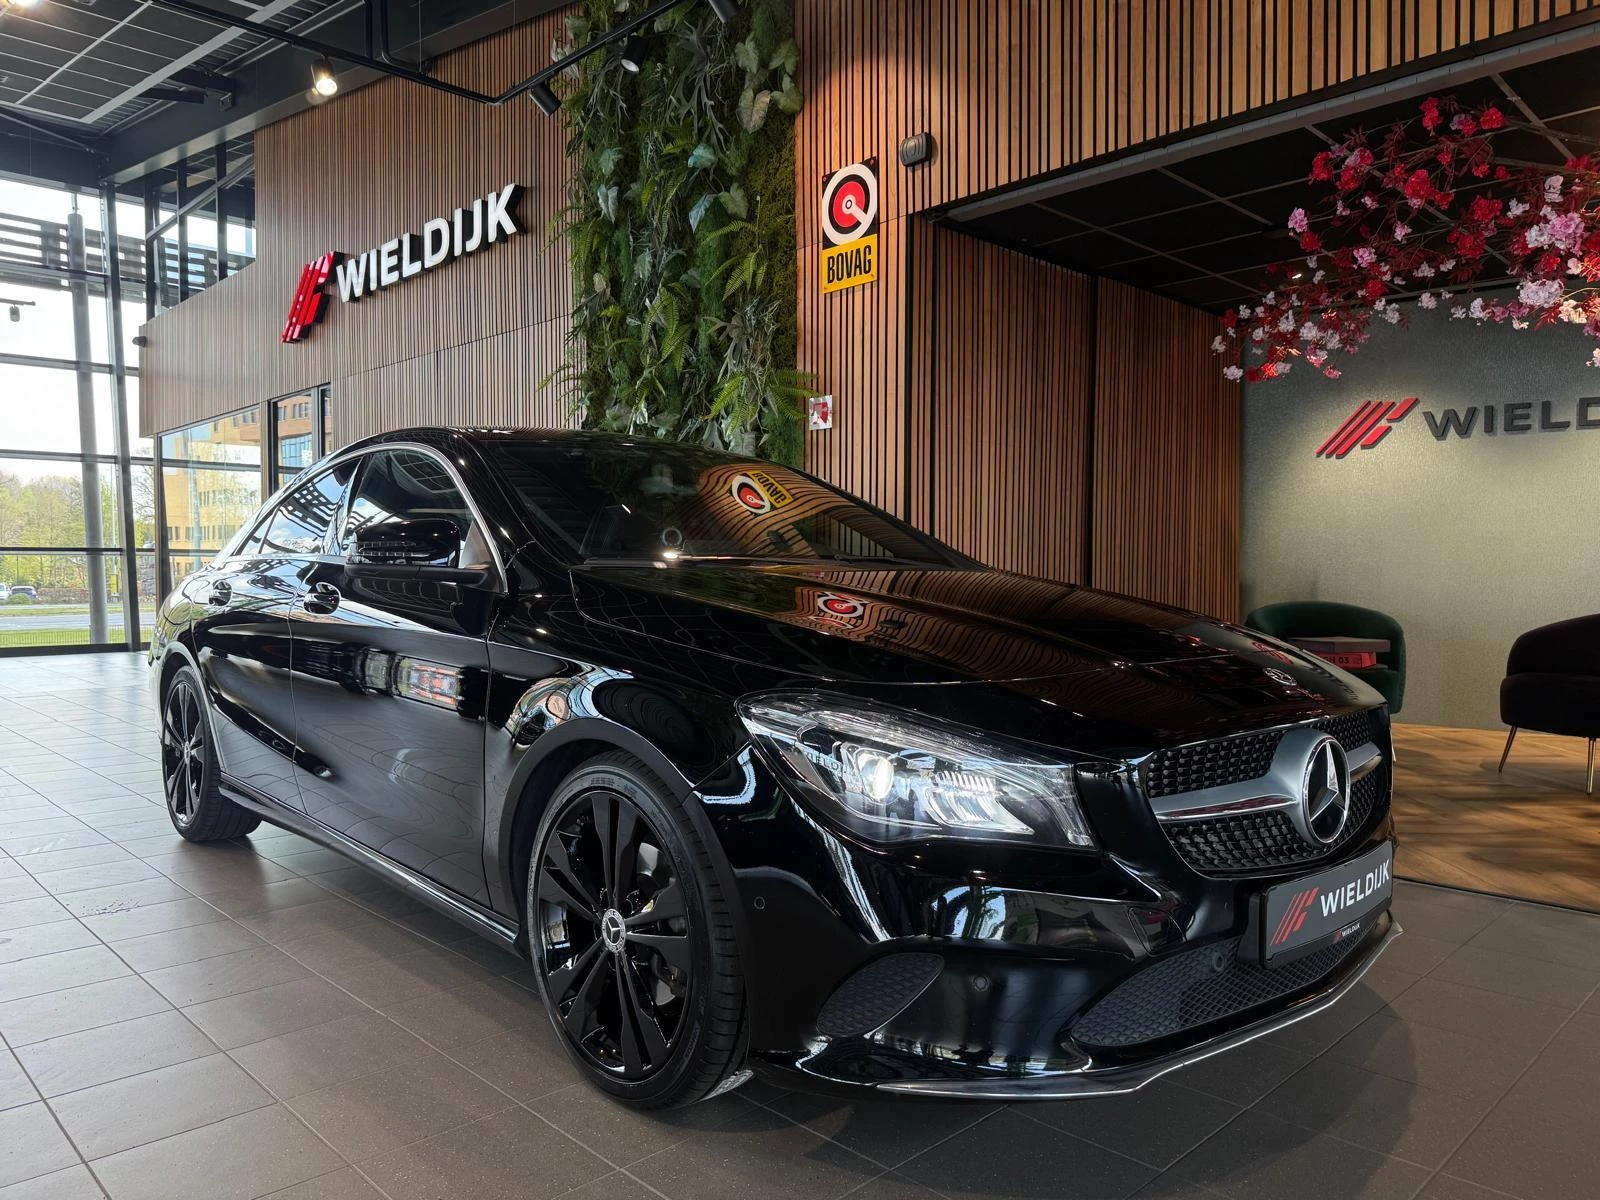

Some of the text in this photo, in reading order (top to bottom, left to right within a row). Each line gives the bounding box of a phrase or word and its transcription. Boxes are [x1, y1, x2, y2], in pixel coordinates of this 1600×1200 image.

[336, 183, 518, 303] WIELDIJK
[827, 244, 872, 284] BOVAG
[1320, 859, 1390, 917] WIELDIJK
